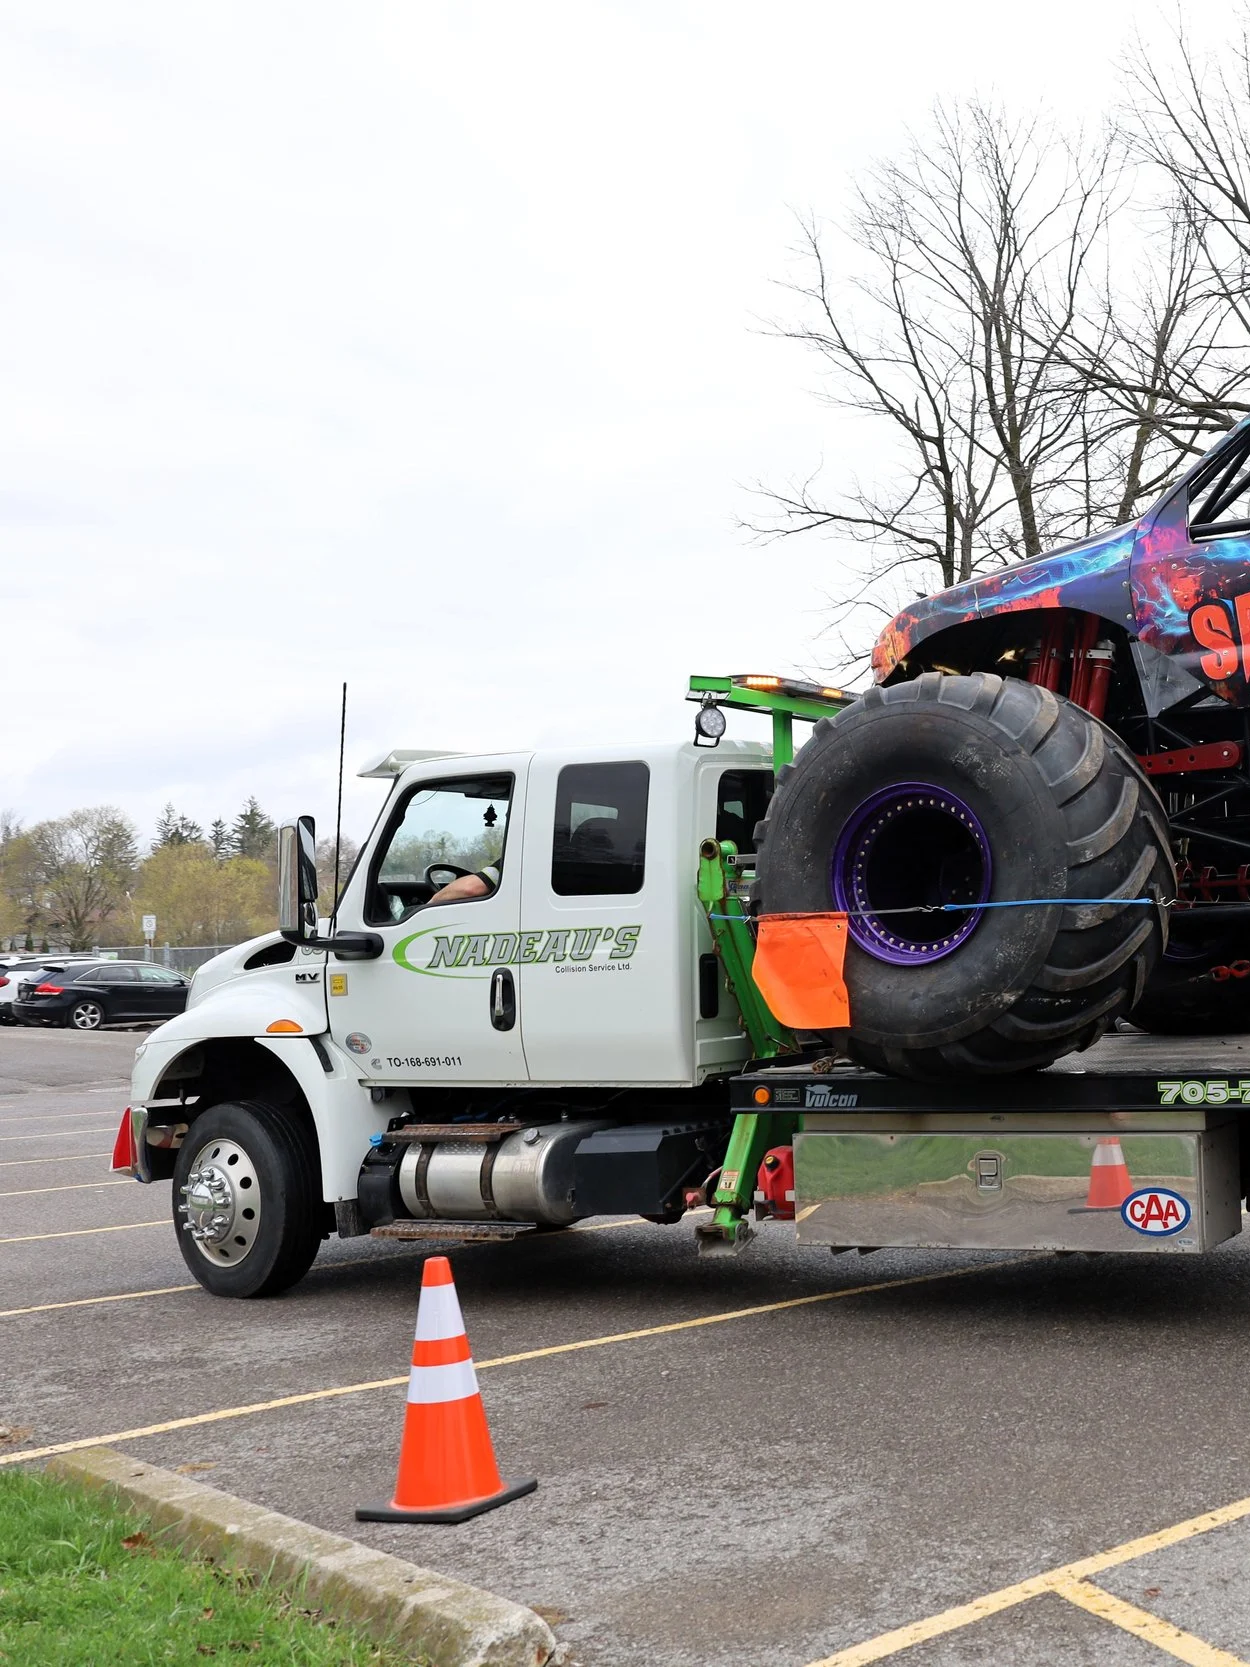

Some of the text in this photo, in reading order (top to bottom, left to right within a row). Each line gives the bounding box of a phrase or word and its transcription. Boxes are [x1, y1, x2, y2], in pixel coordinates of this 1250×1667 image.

[425, 925, 643, 969] NADEAU'S
[555, 962, 632, 974] Collision Service Ltd.
[295, 973, 320, 982] MV
[387, 1056, 462, 1068] TO-168-691-011
[804, 1090, 858, 1108] Vulcan
[1129, 1194, 1181, 1229] CAA
